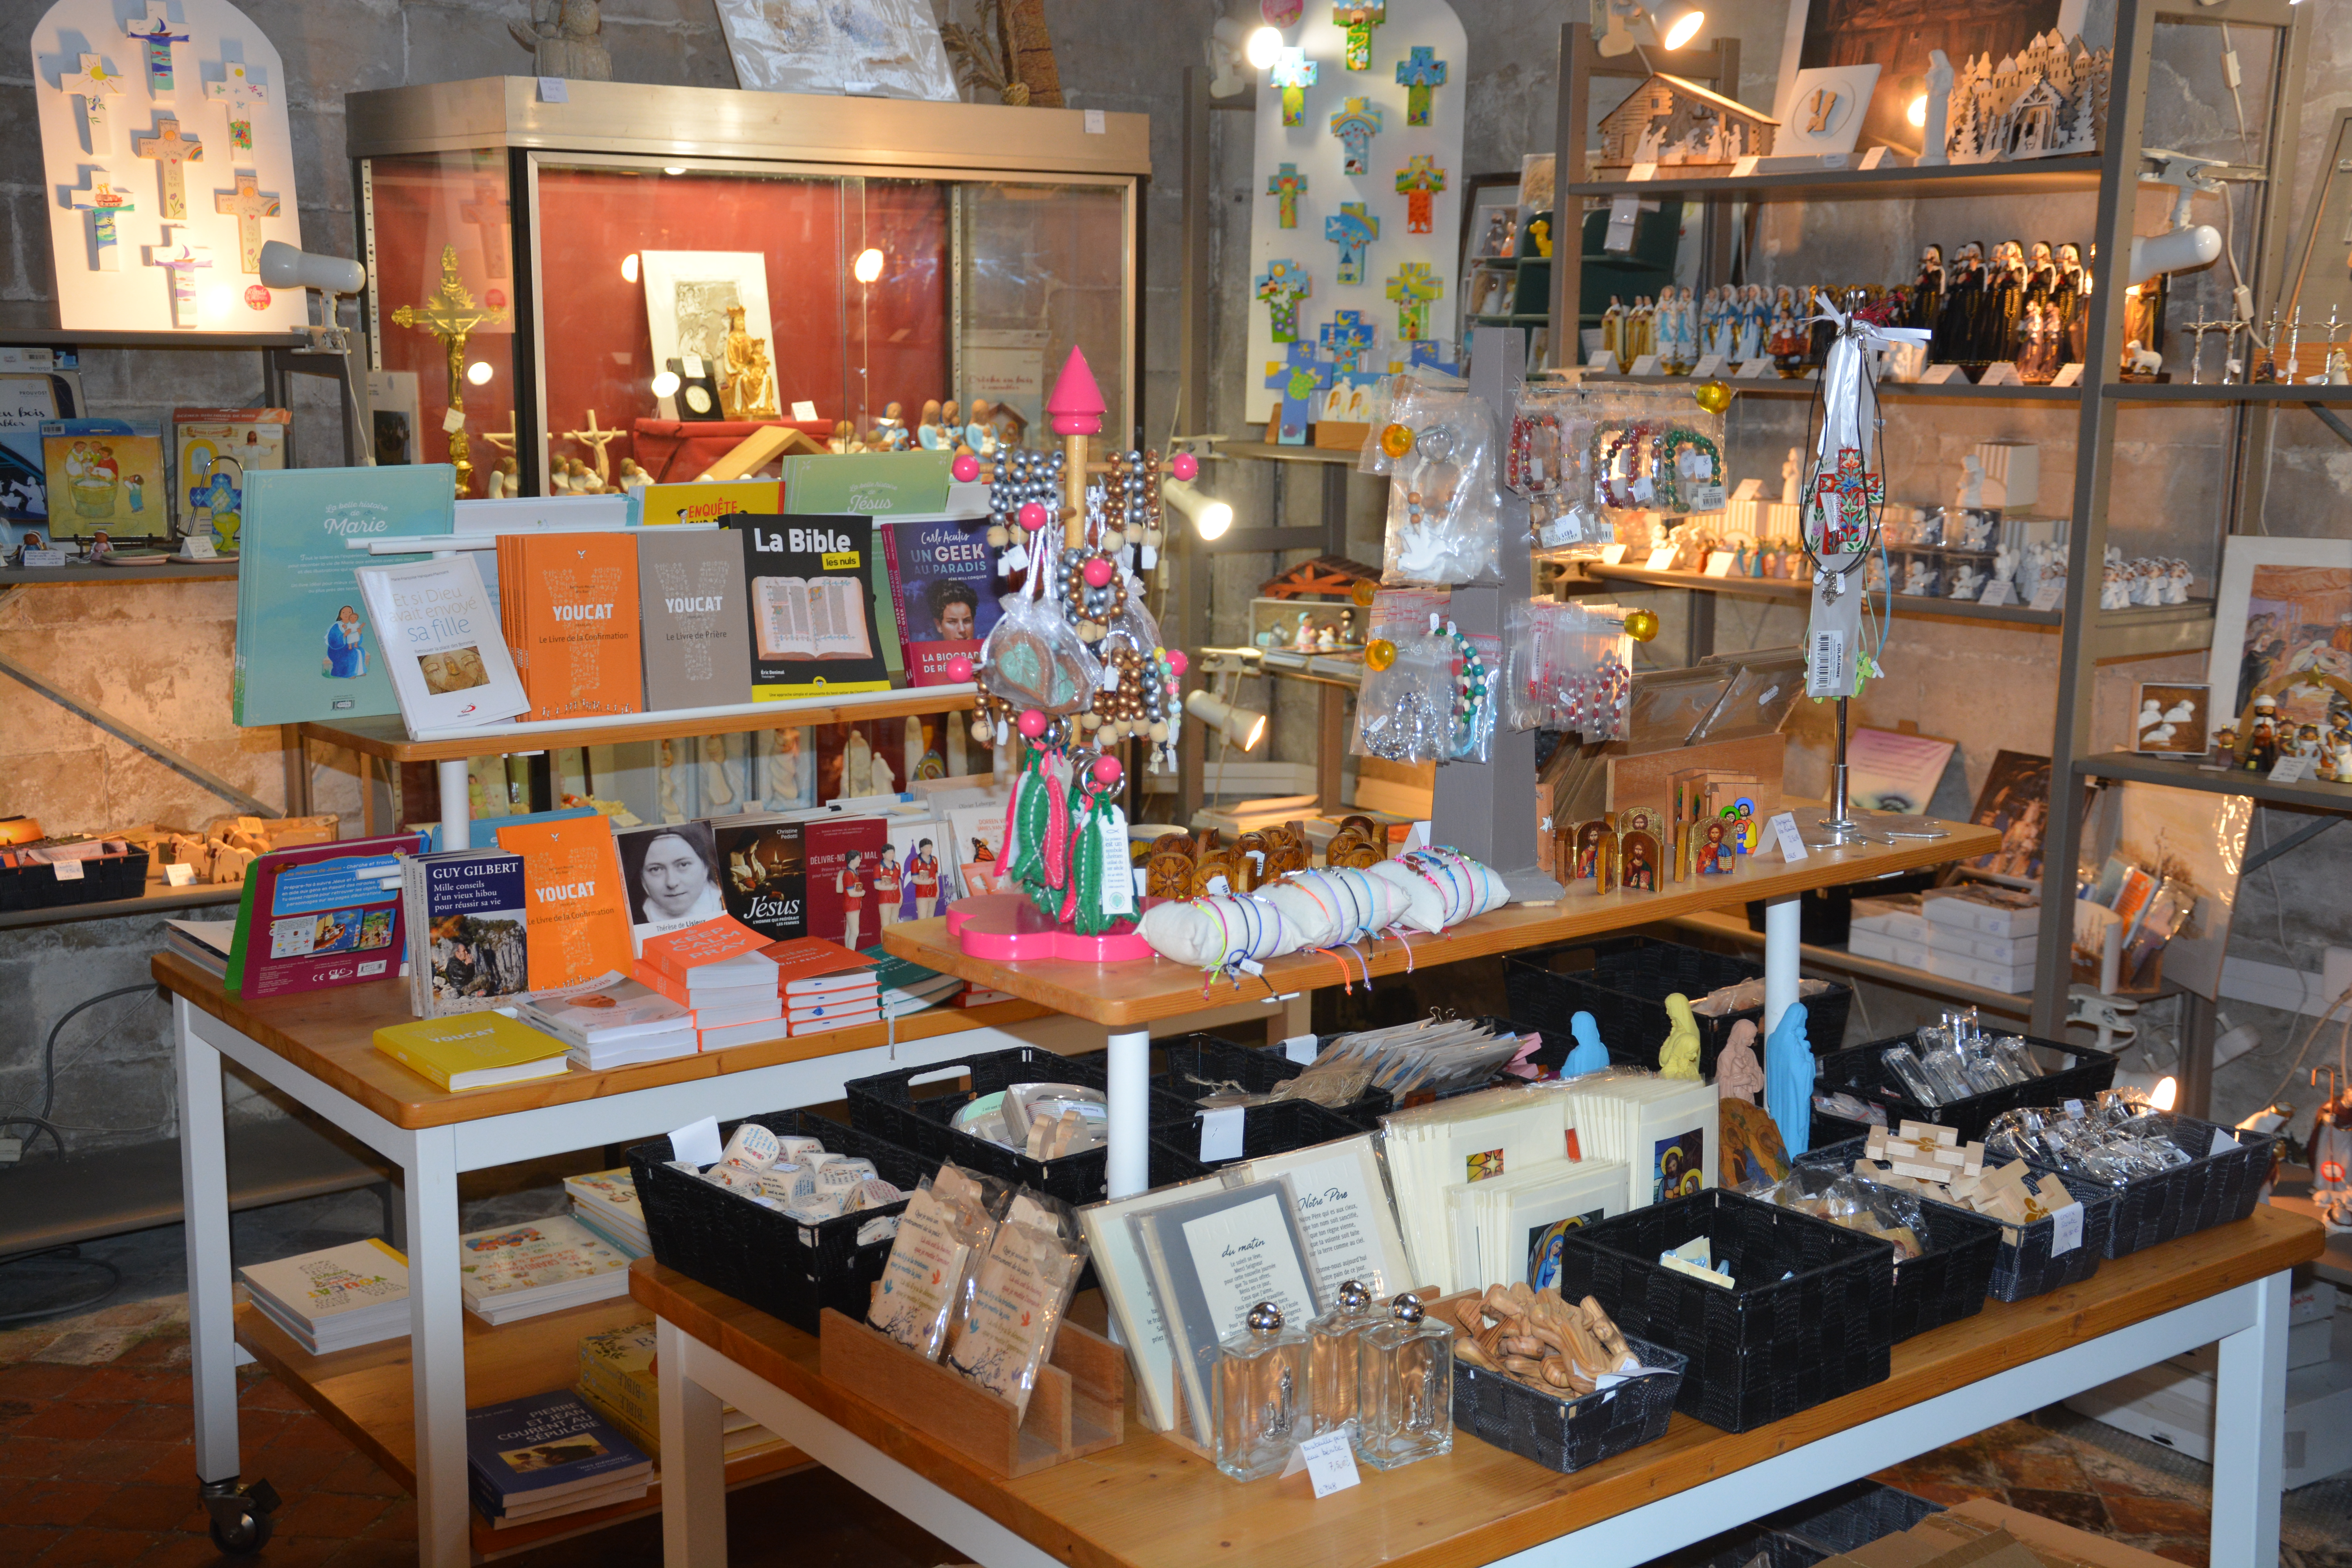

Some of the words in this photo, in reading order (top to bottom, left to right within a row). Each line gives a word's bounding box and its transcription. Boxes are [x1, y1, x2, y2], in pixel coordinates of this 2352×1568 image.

[18, 407, 45, 417] bois
[326, 505, 337, 513] La
[359, 501, 388, 511] histoire
[688, 497, 737, 518] ENQUÊTE
[847, 494, 893, 513] Jésus
[324, 517, 388, 535] Marie
[754, 528, 784, 552] La
[789, 528, 851, 553] Bible
[921, 529, 943, 545] Carlo
[944, 529, 970, 543] Acutis
[826, 558, 838, 566] les
[840, 556, 856, 566] nuls
[911, 549, 932, 562] UN
[935, 543, 985, 562] GEEK
[915, 565, 929, 574] AU
[933, 561, 986, 574] PARADIS
[393, 594, 408, 606] Et
[411, 592, 423, 604] si
[426, 588, 462, 602] Dieu
[666, 596, 722, 613] YOUCAT
[389, 608, 423, 622] avait
[426, 596, 477, 617] envoyé
[552, 604, 613, 621] YOUCAT
[408, 626, 430, 642] sa
[432, 617, 470, 642] fille
[585, 632, 628, 641] Confirmation
[924, 665, 935, 673] DE
[810, 853, 845, 865] DÉLIVRE-NO
[864, 851, 878, 859] MAL
[433, 867, 461, 879] GUY
[464, 862, 518, 876] GILBERT
[434, 884, 454, 892] Mille
[456, 880, 485, 889] conseils
[535, 881, 595, 903] YOUCAT
[434, 893, 452, 901] d'un
[454, 891, 474, 900] vieux
[475, 889, 497, 898] hibou
[435, 904, 452, 913] pour
[455, 900, 479, 909] réussir
[572, 908, 614, 919] Confirmation
[744, 896, 800, 919] Jésus
[669, 927, 724, 945] KEEP
[673, 930, 741, 951] CALM
[689, 939, 746, 959] PRAY
[561, 978, 611, 994] François
[429, 1028, 495, 1043] YOUCAT
[1298, 1193, 1323, 1211] Notre
[1324, 1187, 1348, 1201] Père
[1339, 1212, 1358, 1221] sanctifié,
[1327, 1225, 1339, 1234] règne
[1222, 1244, 1236, 1257] du
[1238, 1237, 1265, 1252] matin
[1316, 1261, 1341, 1274] Donne-nous
[1343, 1254, 1367, 1267] aujourd'hui
[1334, 1271, 1343, 1280] pain
[1356, 1264, 1366, 1273] jour.
[307, 1275, 387, 1298] YOUCAT
[526, 1419, 543, 1427] ET
[550, 1409, 586, 1422] JEAN
[529, 1402, 580, 1418] PIERRE
[497, 1420, 565, 1440] COURENT
[572, 1415, 592, 1424] AU
[526, 1420, 601, 1443] SÉPULCRE
[1303, 1437, 1333, 1451] bouteille
[1322, 1445, 1343, 1455] bénite
[1319, 1483, 1337, 1494] 0748
